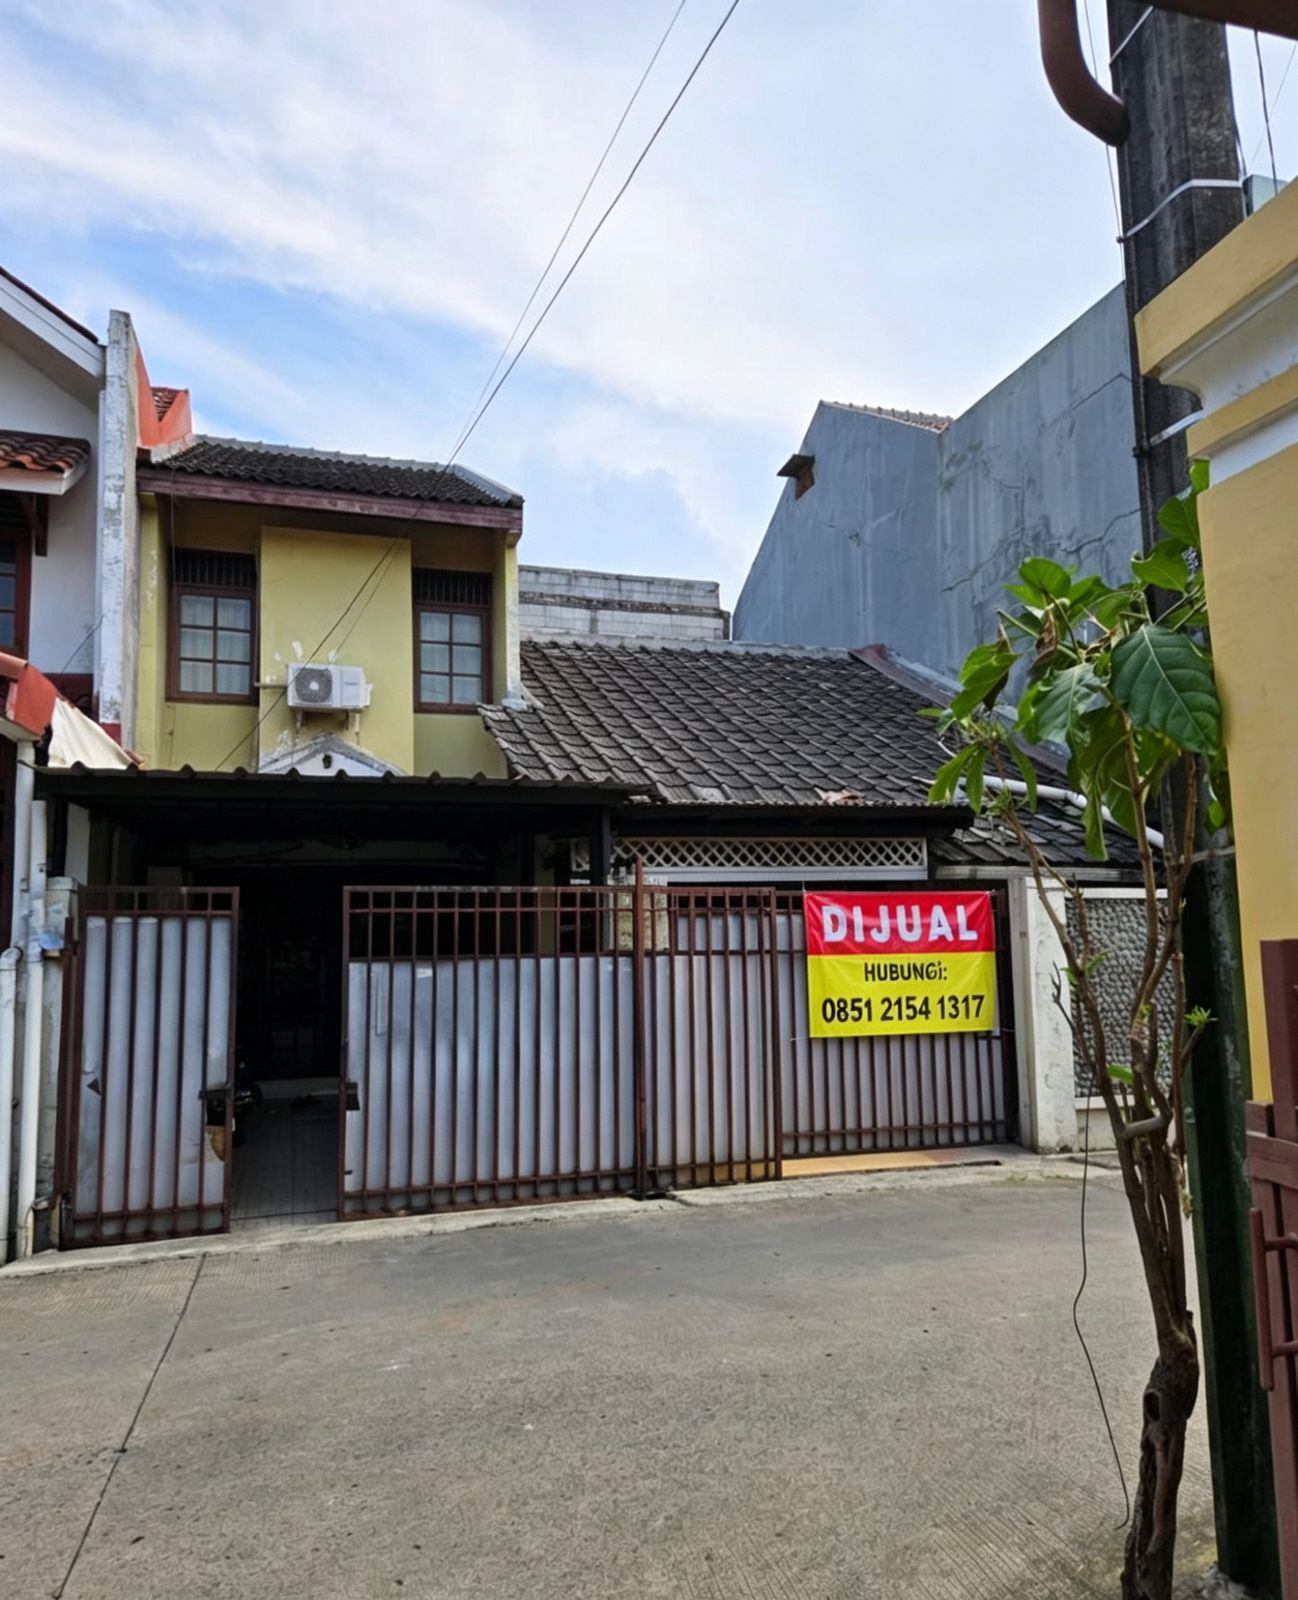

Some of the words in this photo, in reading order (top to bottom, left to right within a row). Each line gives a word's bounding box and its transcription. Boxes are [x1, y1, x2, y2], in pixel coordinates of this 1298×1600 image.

[821, 904, 978, 943] DIJUAL
[821, 997, 873, 1023] 0851
[880, 995, 932, 1021] 2154
[937, 994, 985, 1020] 1317
